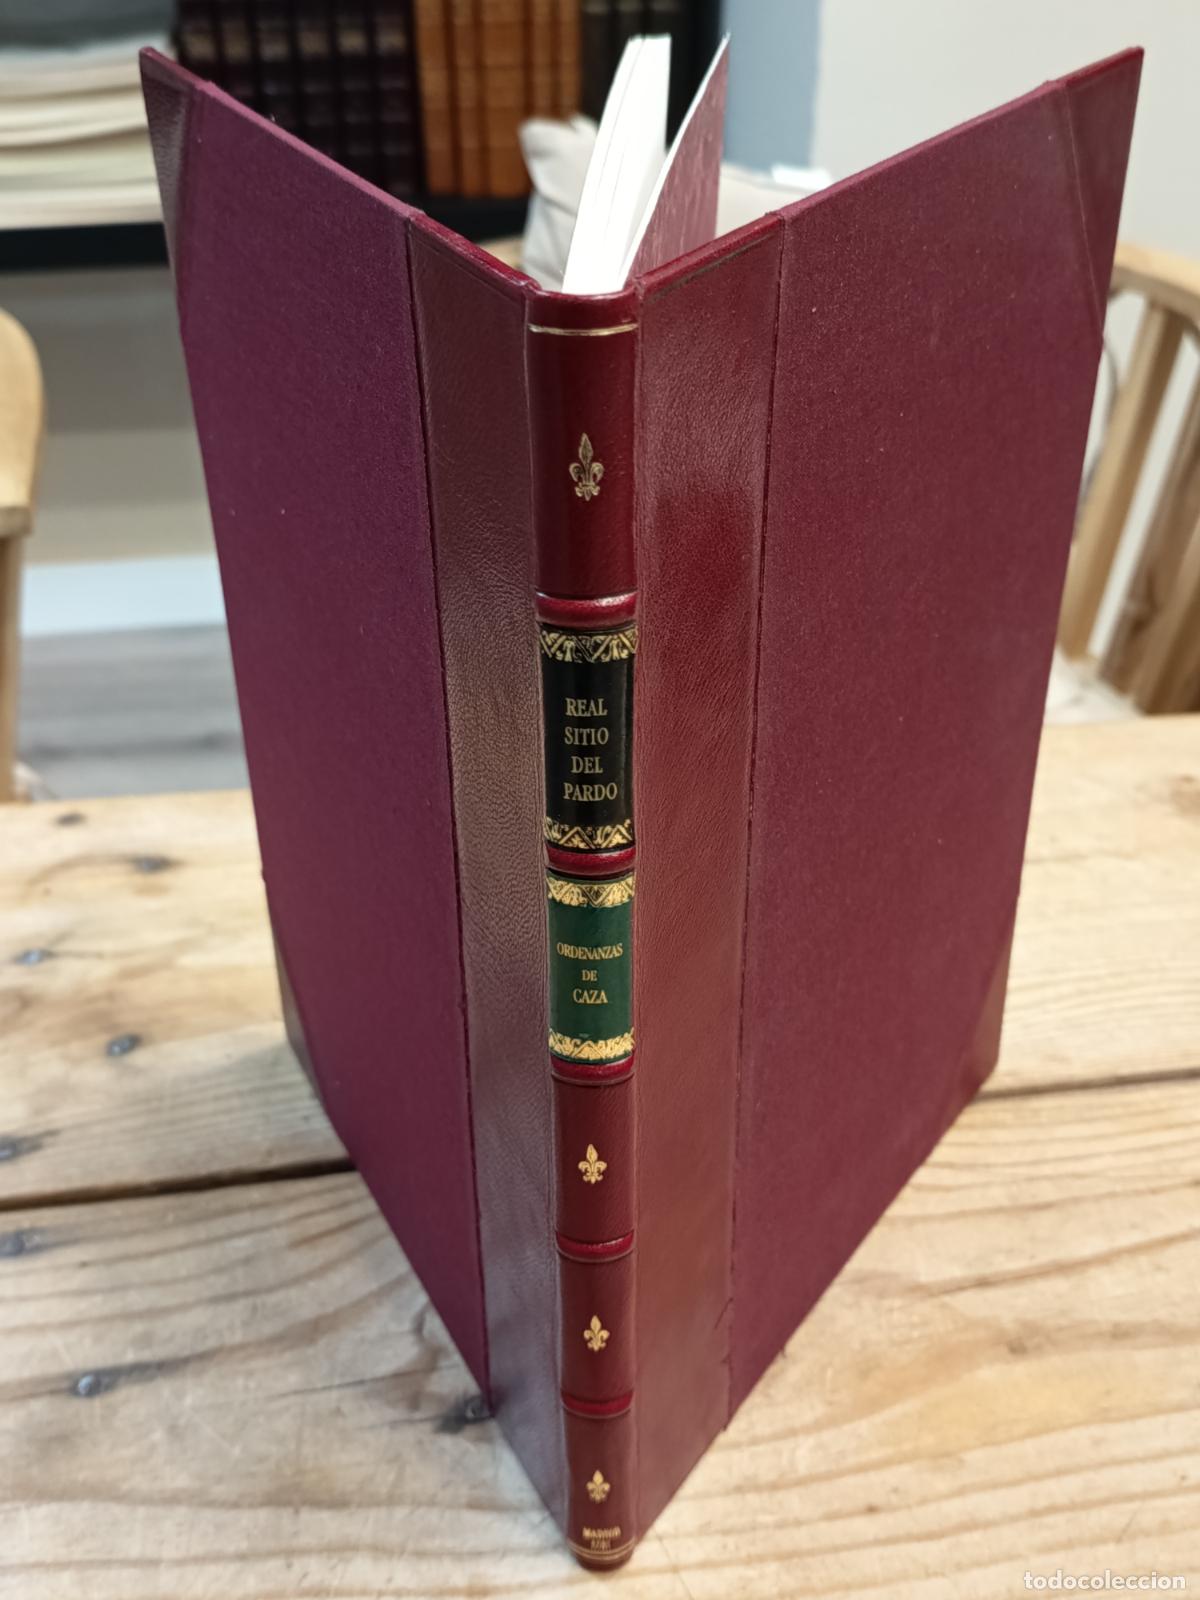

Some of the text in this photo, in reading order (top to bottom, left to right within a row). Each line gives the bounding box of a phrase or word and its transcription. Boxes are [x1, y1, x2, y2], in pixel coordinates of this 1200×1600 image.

[565, 698, 608, 717] REAL
[564, 726, 609, 746] SITIO
[571, 756, 603, 774] DEL
[563, 782, 618, 802] PARDO
[556, 942, 624, 960] ORDENANZAS
[581, 969, 597, 982] DE
[572, 988, 608, 1004] CAZA
